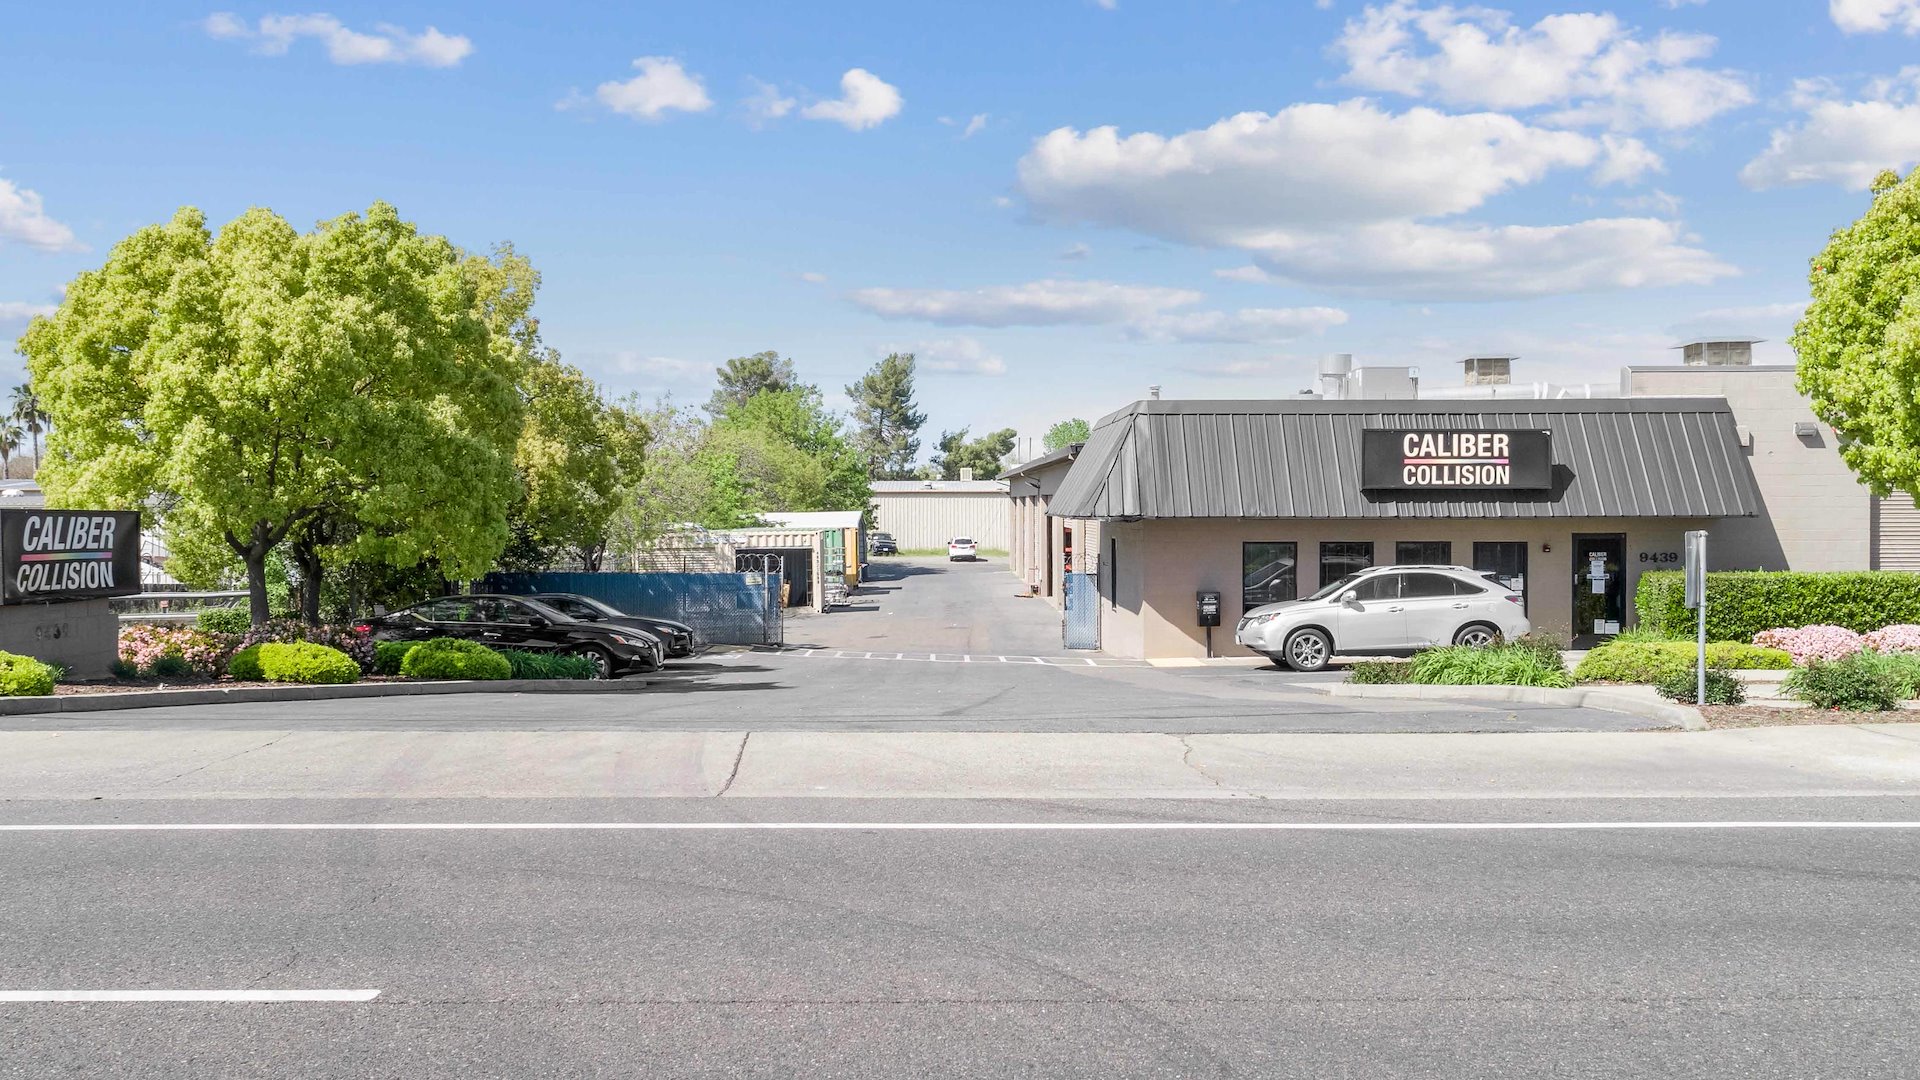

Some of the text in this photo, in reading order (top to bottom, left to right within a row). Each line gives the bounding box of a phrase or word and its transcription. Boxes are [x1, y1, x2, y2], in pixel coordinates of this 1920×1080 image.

[1403, 433, 1509, 457] CALIBER
[1403, 465, 1510, 485] COLLISION
[23, 515, 116, 551] CALIBER
[1640, 552, 1678, 563] 9439
[16, 561, 115, 593] COLLISION
